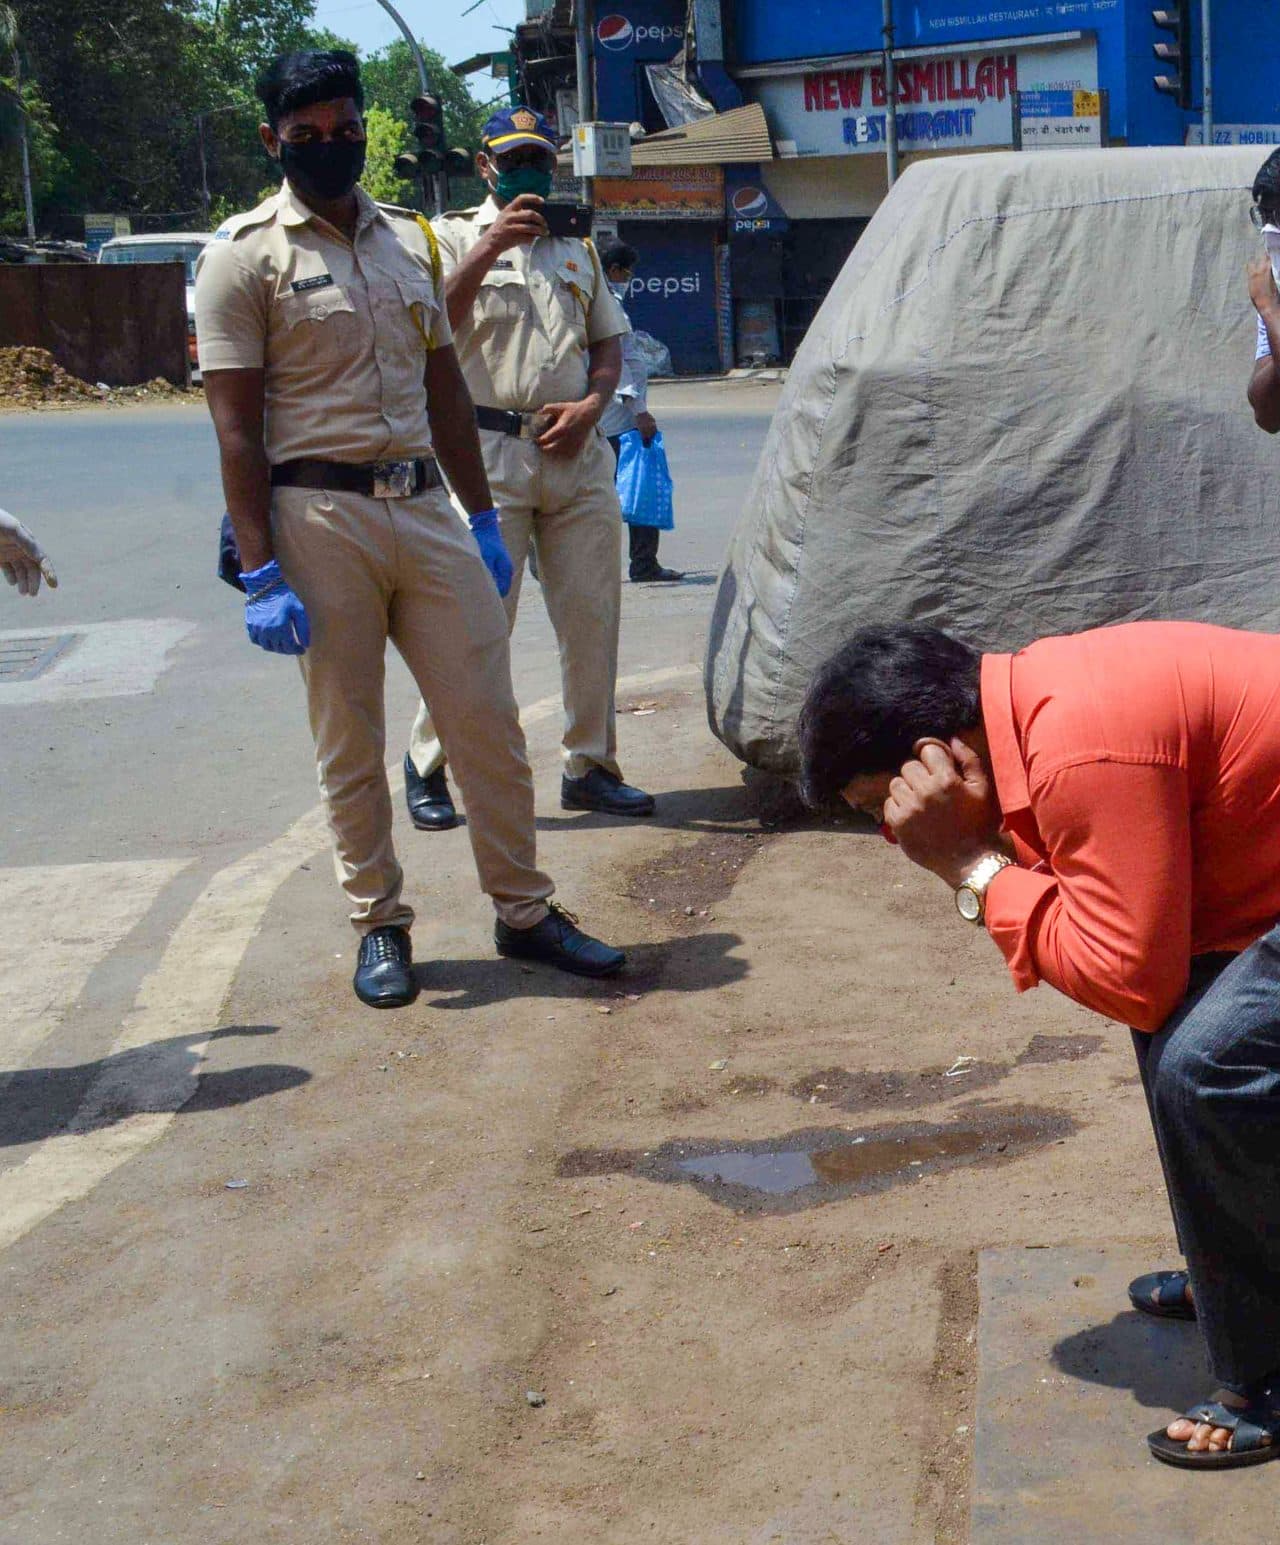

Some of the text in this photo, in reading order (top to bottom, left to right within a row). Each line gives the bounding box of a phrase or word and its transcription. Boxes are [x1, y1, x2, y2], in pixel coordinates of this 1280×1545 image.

[989, 9, 1040, 22] RESTAURANT
[636, 24, 683, 44] peps
[803, 70, 864, 112] NEW
[870, 53, 1018, 107] BSMILLAH
[735, 219, 770, 232] pepsi
[630, 272, 700, 298] pepsi
